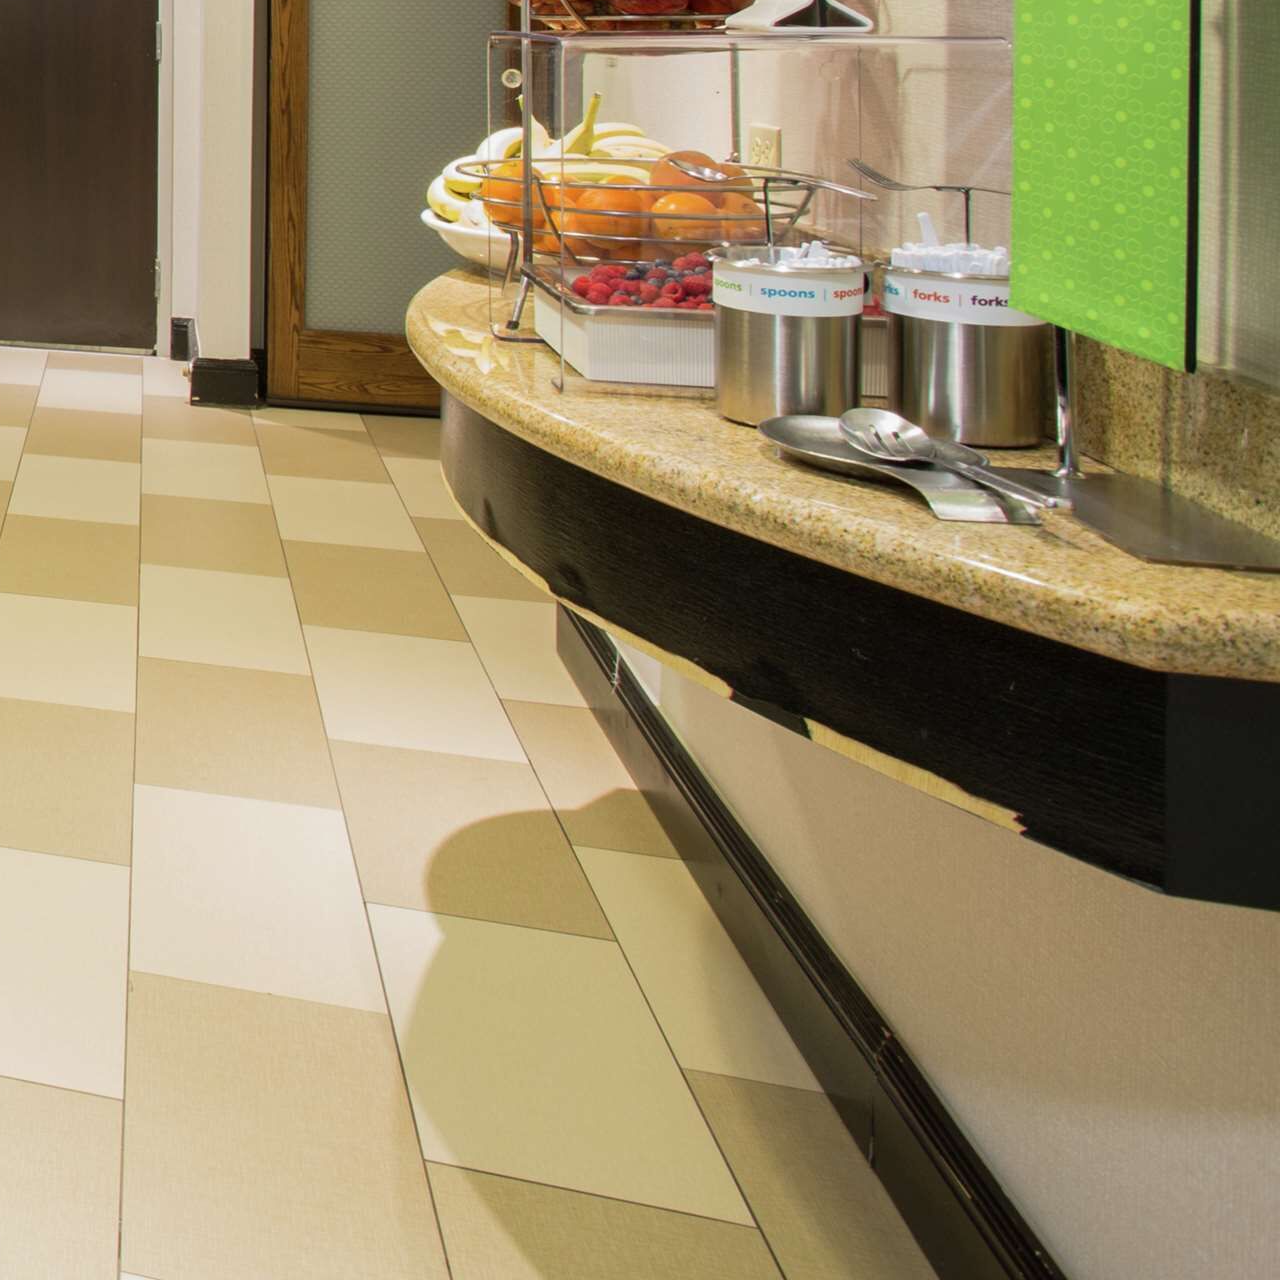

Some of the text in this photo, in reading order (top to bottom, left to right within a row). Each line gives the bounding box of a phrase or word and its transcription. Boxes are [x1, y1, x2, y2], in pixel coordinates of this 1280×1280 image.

[760, 286, 816, 300] spoons
[833, 287, 864, 300] spoon
[912, 288, 951, 304] forks
